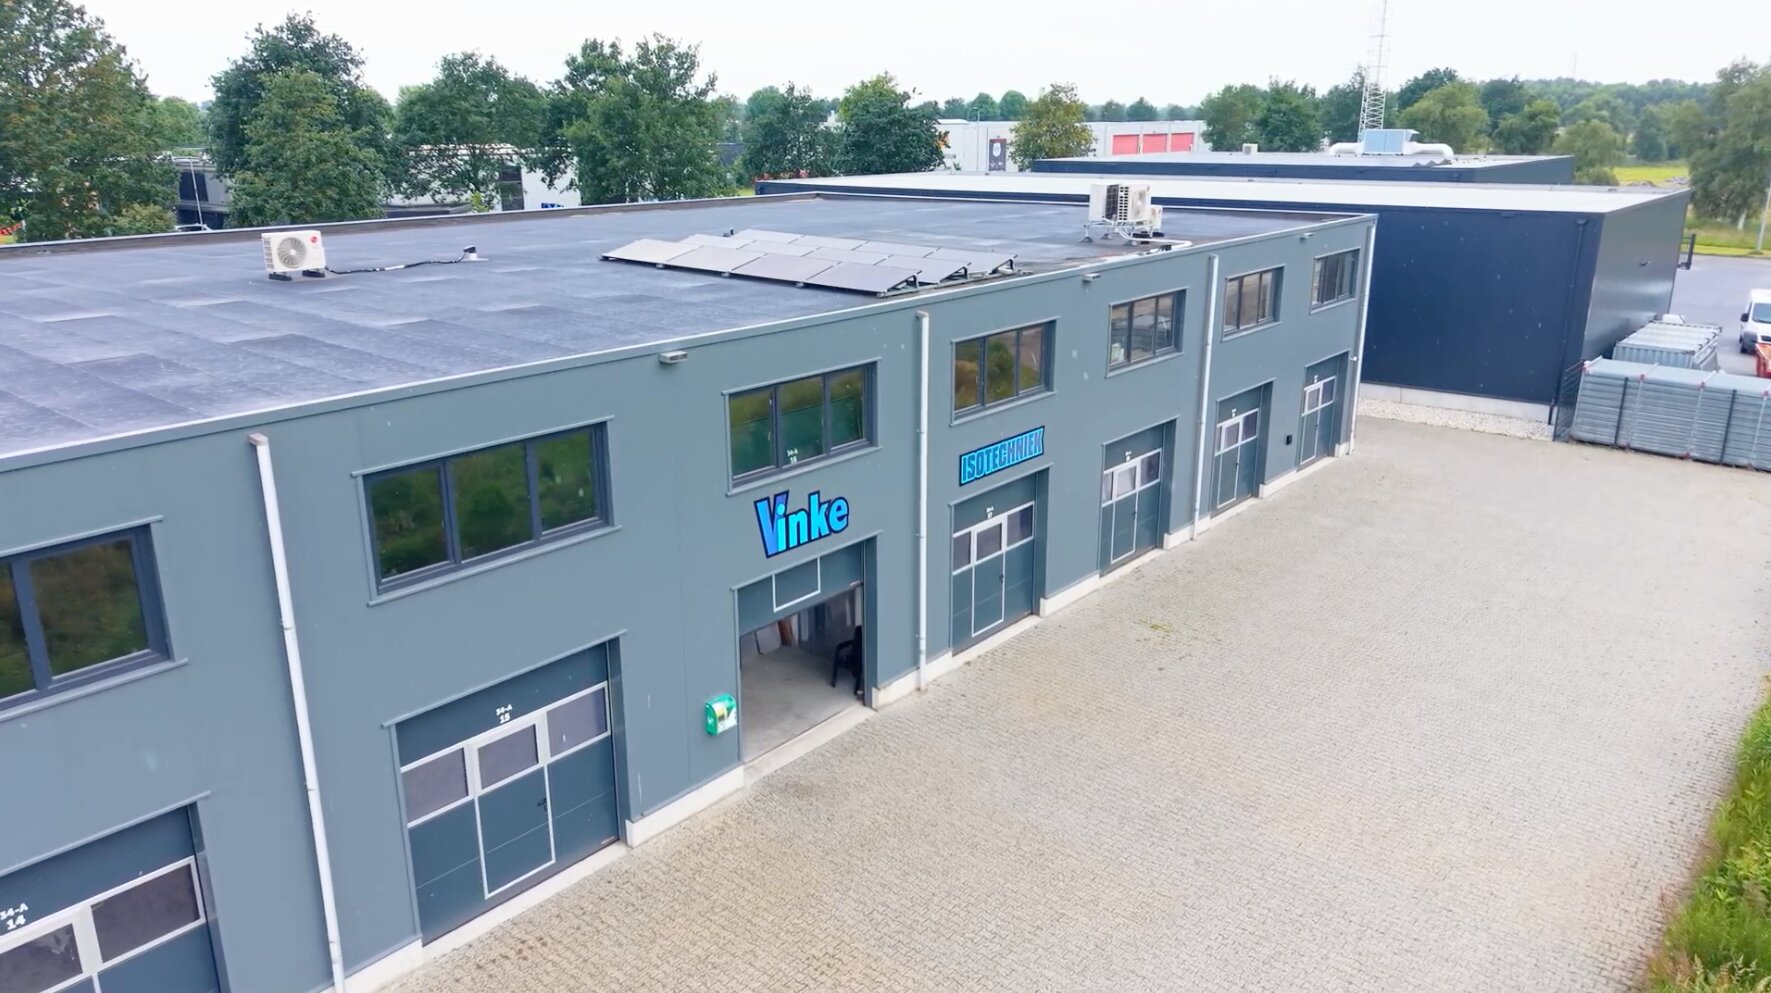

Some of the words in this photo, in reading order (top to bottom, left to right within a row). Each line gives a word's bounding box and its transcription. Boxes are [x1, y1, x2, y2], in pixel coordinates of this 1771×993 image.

[960, 426, 1044, 485] ISOTECHNIEK
[754, 490, 849, 558] Vinke
[6, 914, 26, 930] 14
